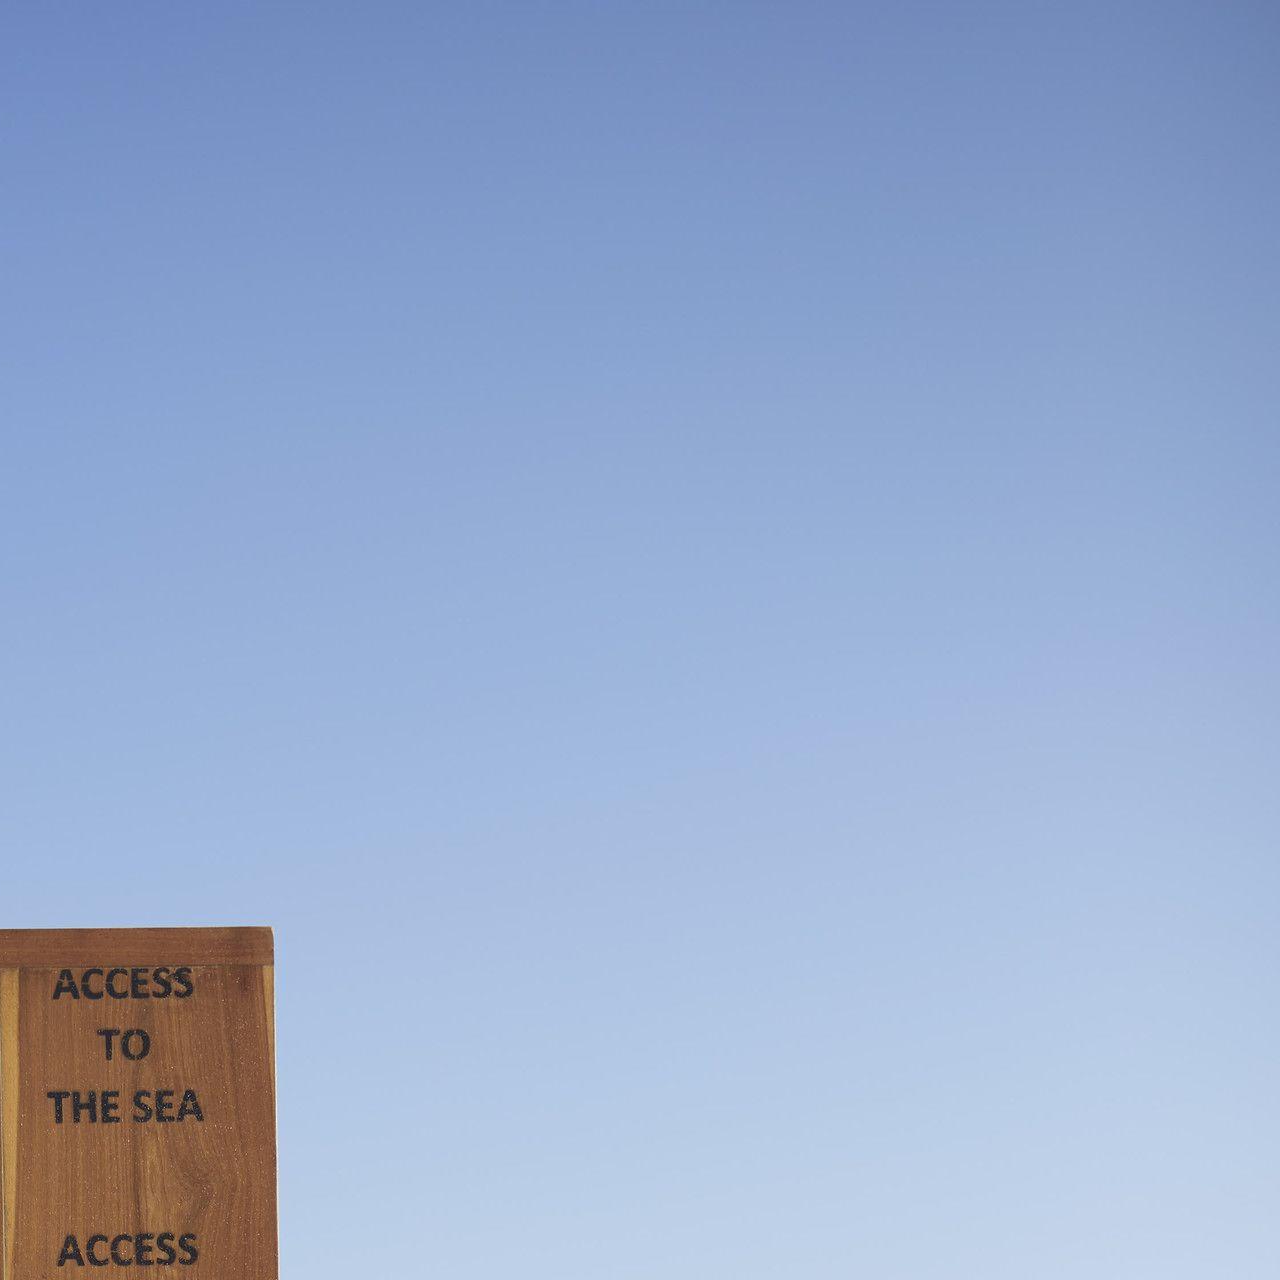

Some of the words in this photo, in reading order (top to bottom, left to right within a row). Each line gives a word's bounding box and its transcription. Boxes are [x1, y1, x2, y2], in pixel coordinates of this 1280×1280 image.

[53, 967, 195, 1001] ACCESS
[97, 1029, 152, 1062] TO
[47, 1091, 121, 1125] THE
[133, 1090, 205, 1124] SEA
[58, 1233, 200, 1268] ACCESS
